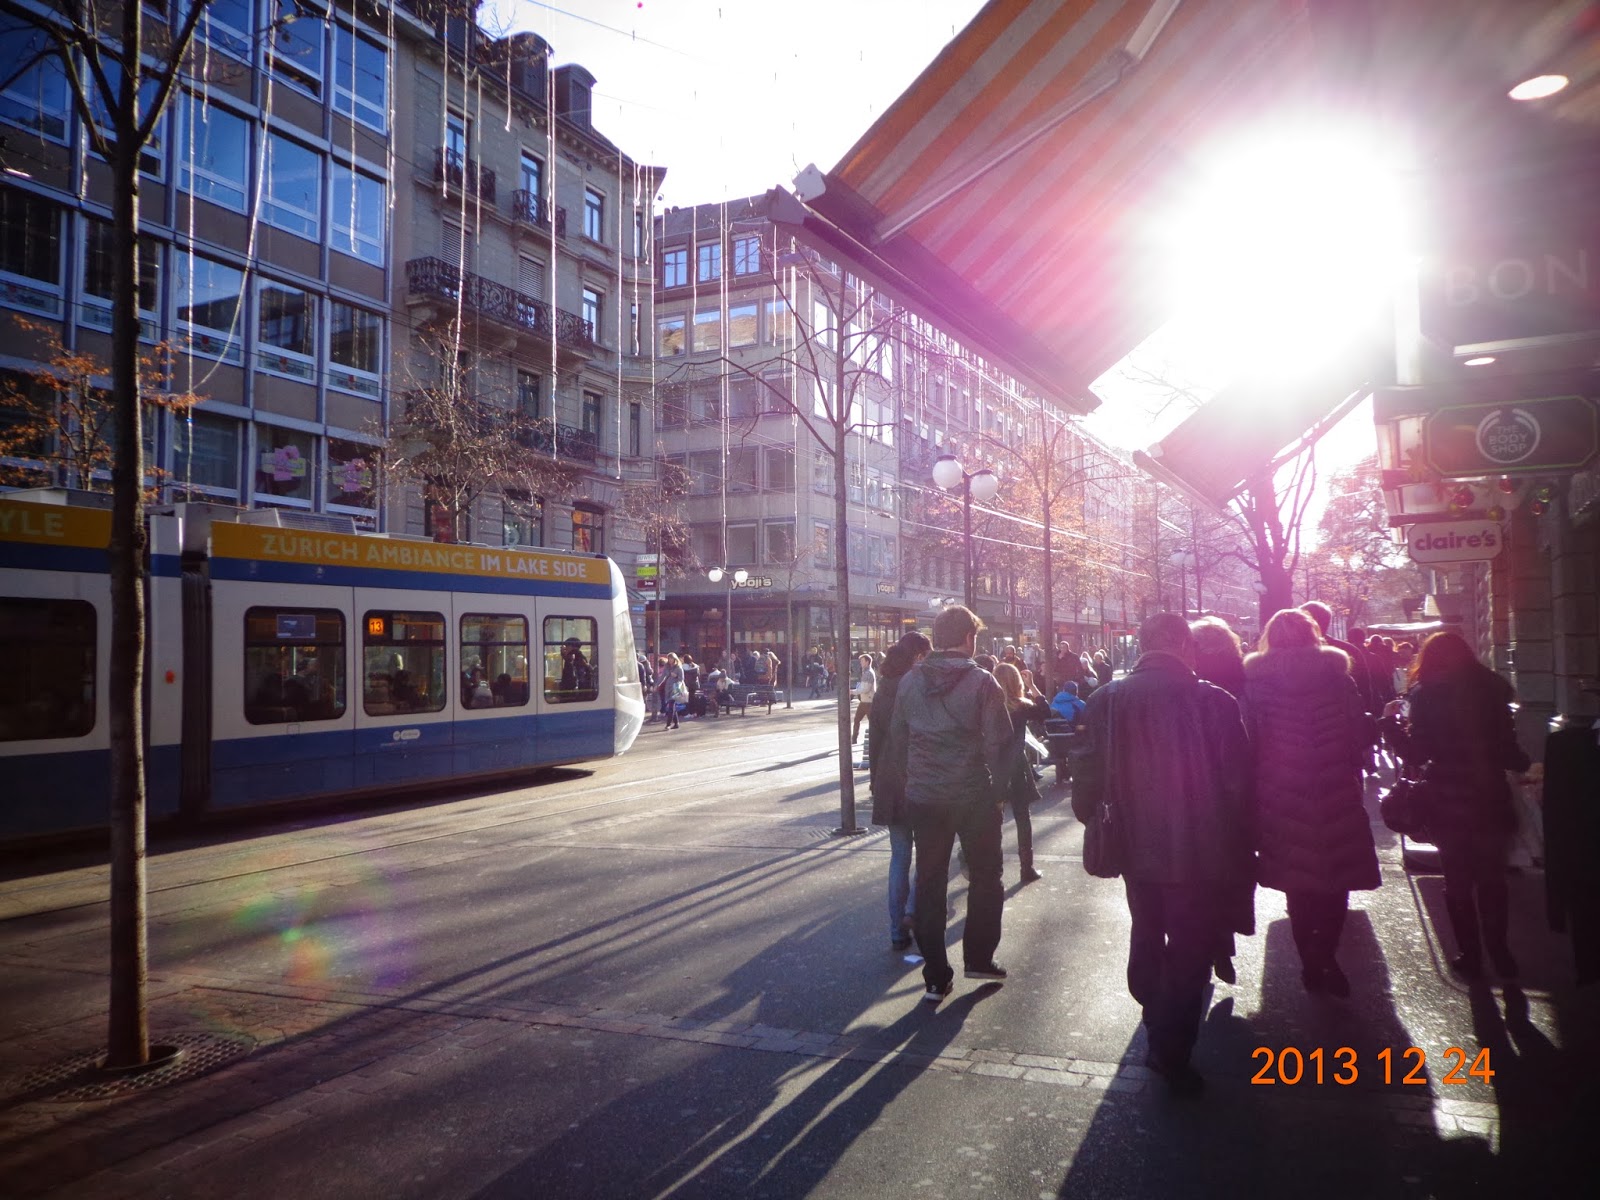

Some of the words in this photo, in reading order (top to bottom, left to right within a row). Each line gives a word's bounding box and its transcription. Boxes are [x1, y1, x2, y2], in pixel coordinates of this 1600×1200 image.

[1447, 249, 1589, 307] BON
[1495, 425, 1520, 435] THE
[1489, 431, 1529, 445] BODY
[1490, 443, 1527, 455] SHOP
[1414, 530, 1497, 551] claire's
[260, 529, 359, 561] ZÜRICH
[366, 544, 475, 570] AMBIANCE
[480, 554, 501, 572] IM
[506, 556, 549, 576] LAKE
[553, 560, 587, 578] SIDE
[370, 621, 383, 633] 13
